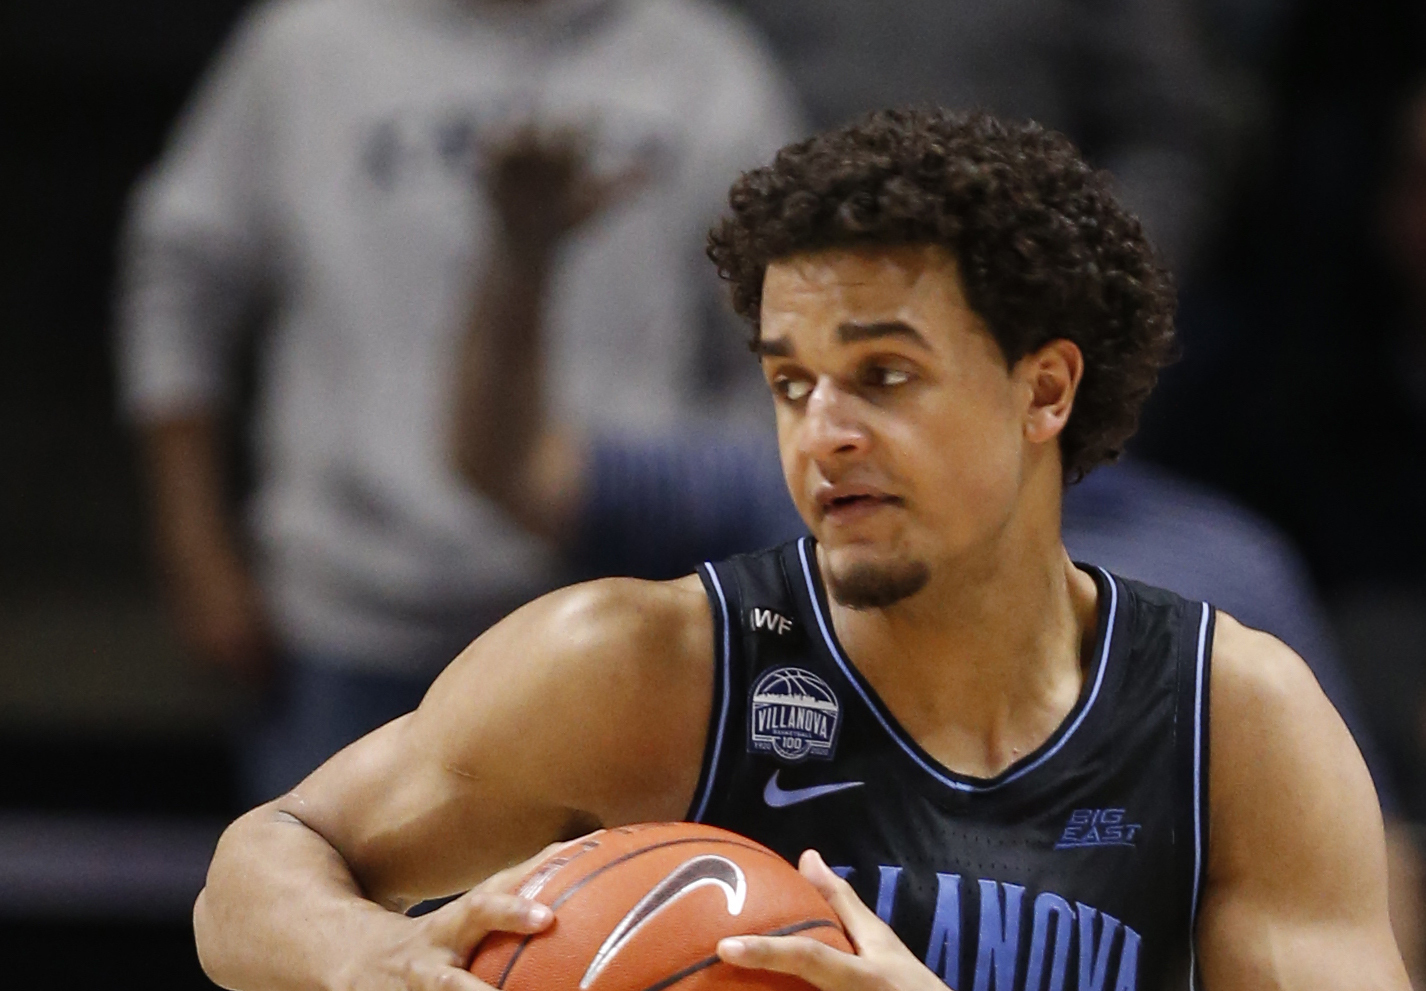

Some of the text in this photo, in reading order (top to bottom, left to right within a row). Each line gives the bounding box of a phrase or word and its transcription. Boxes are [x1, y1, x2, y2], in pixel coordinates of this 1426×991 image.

[758, 705, 828, 739] VILLANOVA
[782, 737, 802, 749] 100
[1071, 808, 1126, 825] BIG
[1060, 824, 1142, 842] EAST
